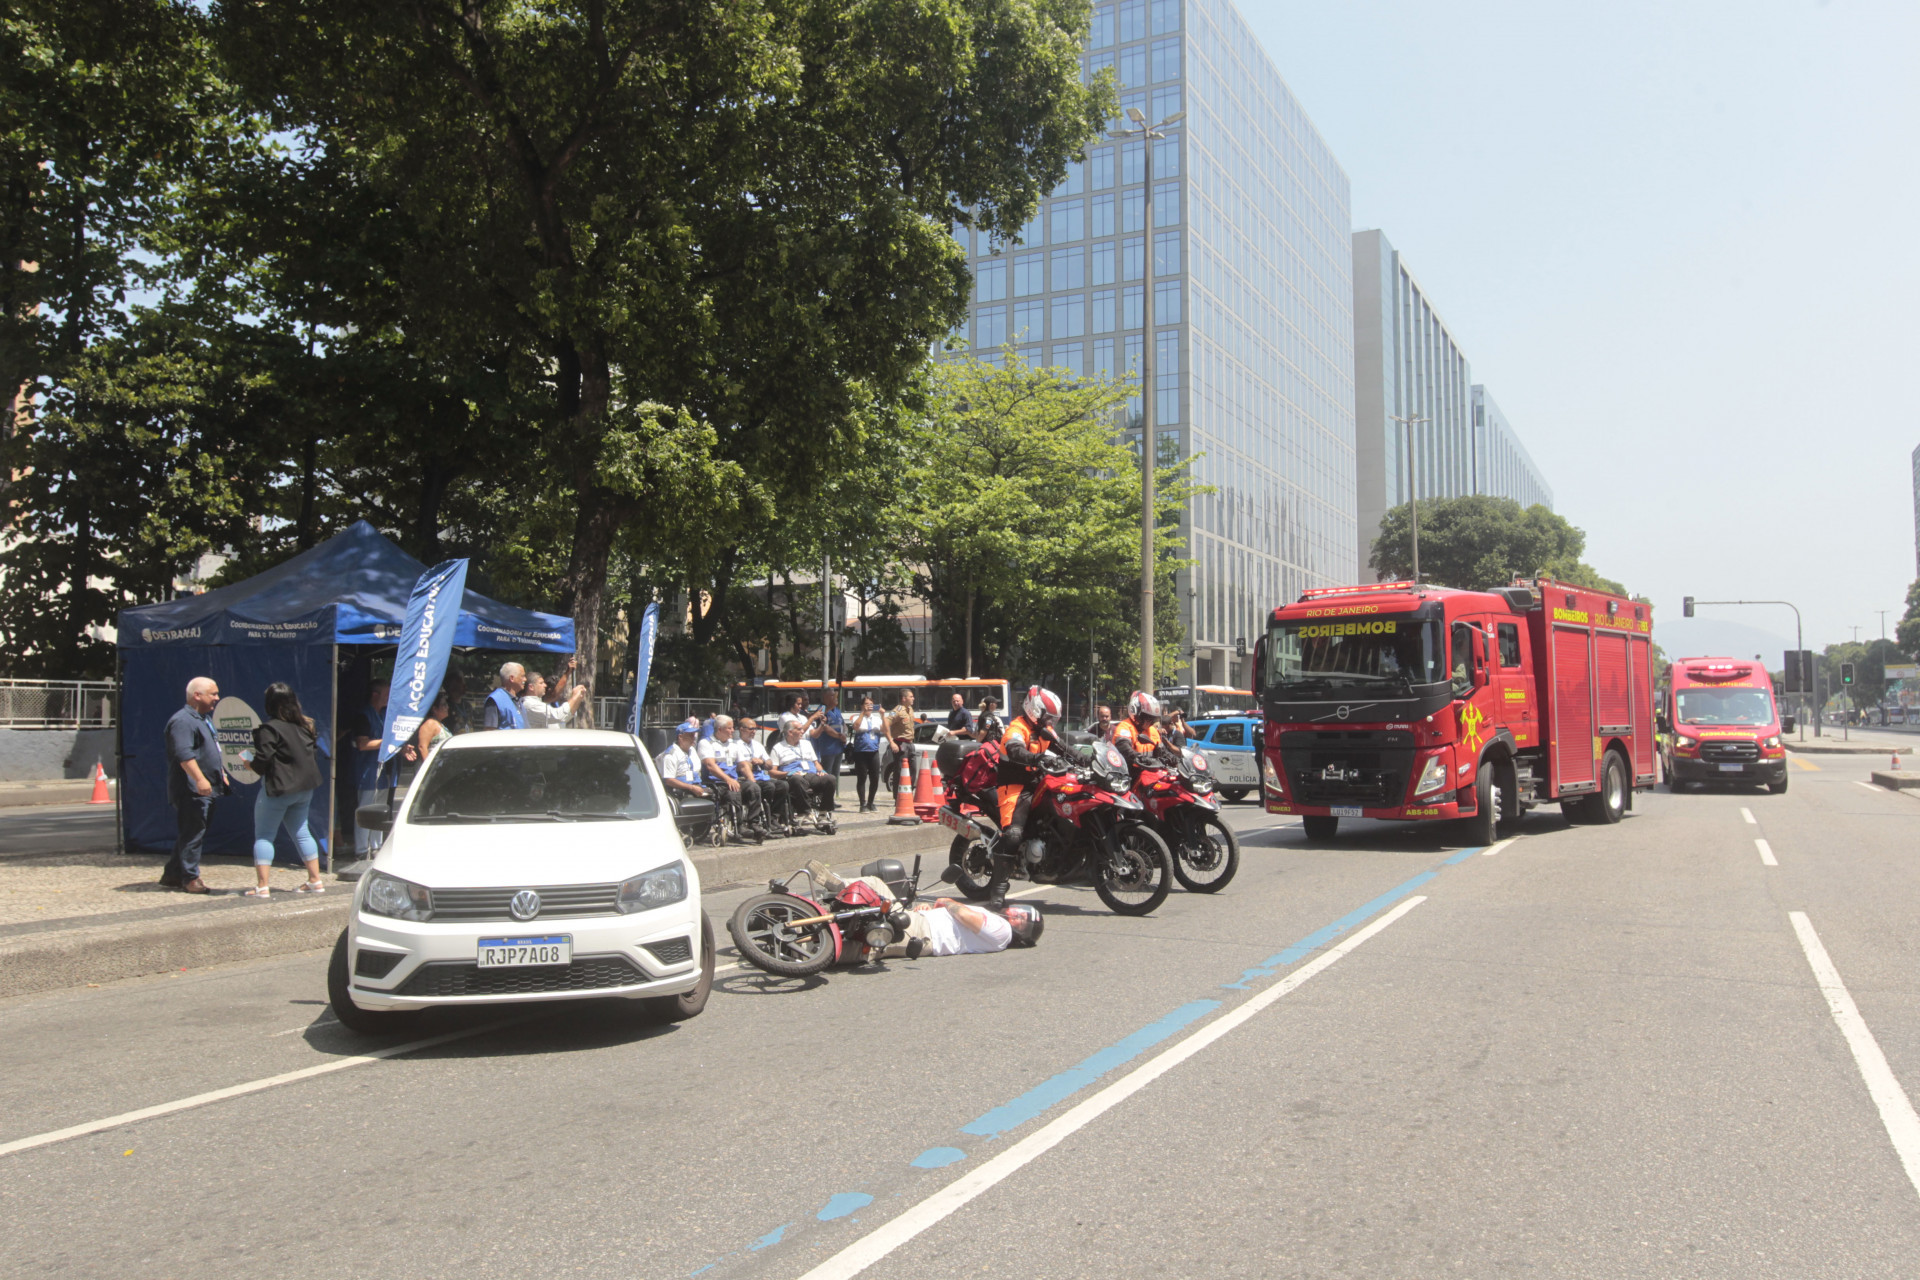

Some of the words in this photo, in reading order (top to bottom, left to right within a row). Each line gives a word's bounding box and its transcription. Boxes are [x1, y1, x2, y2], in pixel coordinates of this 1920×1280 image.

[1323, 608, 1337, 616] DE
[1338, 605, 1379, 616] JANEIRO
[1553, 607, 1589, 624] BOMBEIROS
[283, 620, 318, 630] EDUCAÇÃO
[408, 662, 427, 712] AÇÕES
[219, 731, 254, 745] EDUCAÇÃ
[1229, 774, 1258, 783] POLÍCIA
[941, 811, 959, 831] 193
[485, 946, 560, 965] RJP7A08
